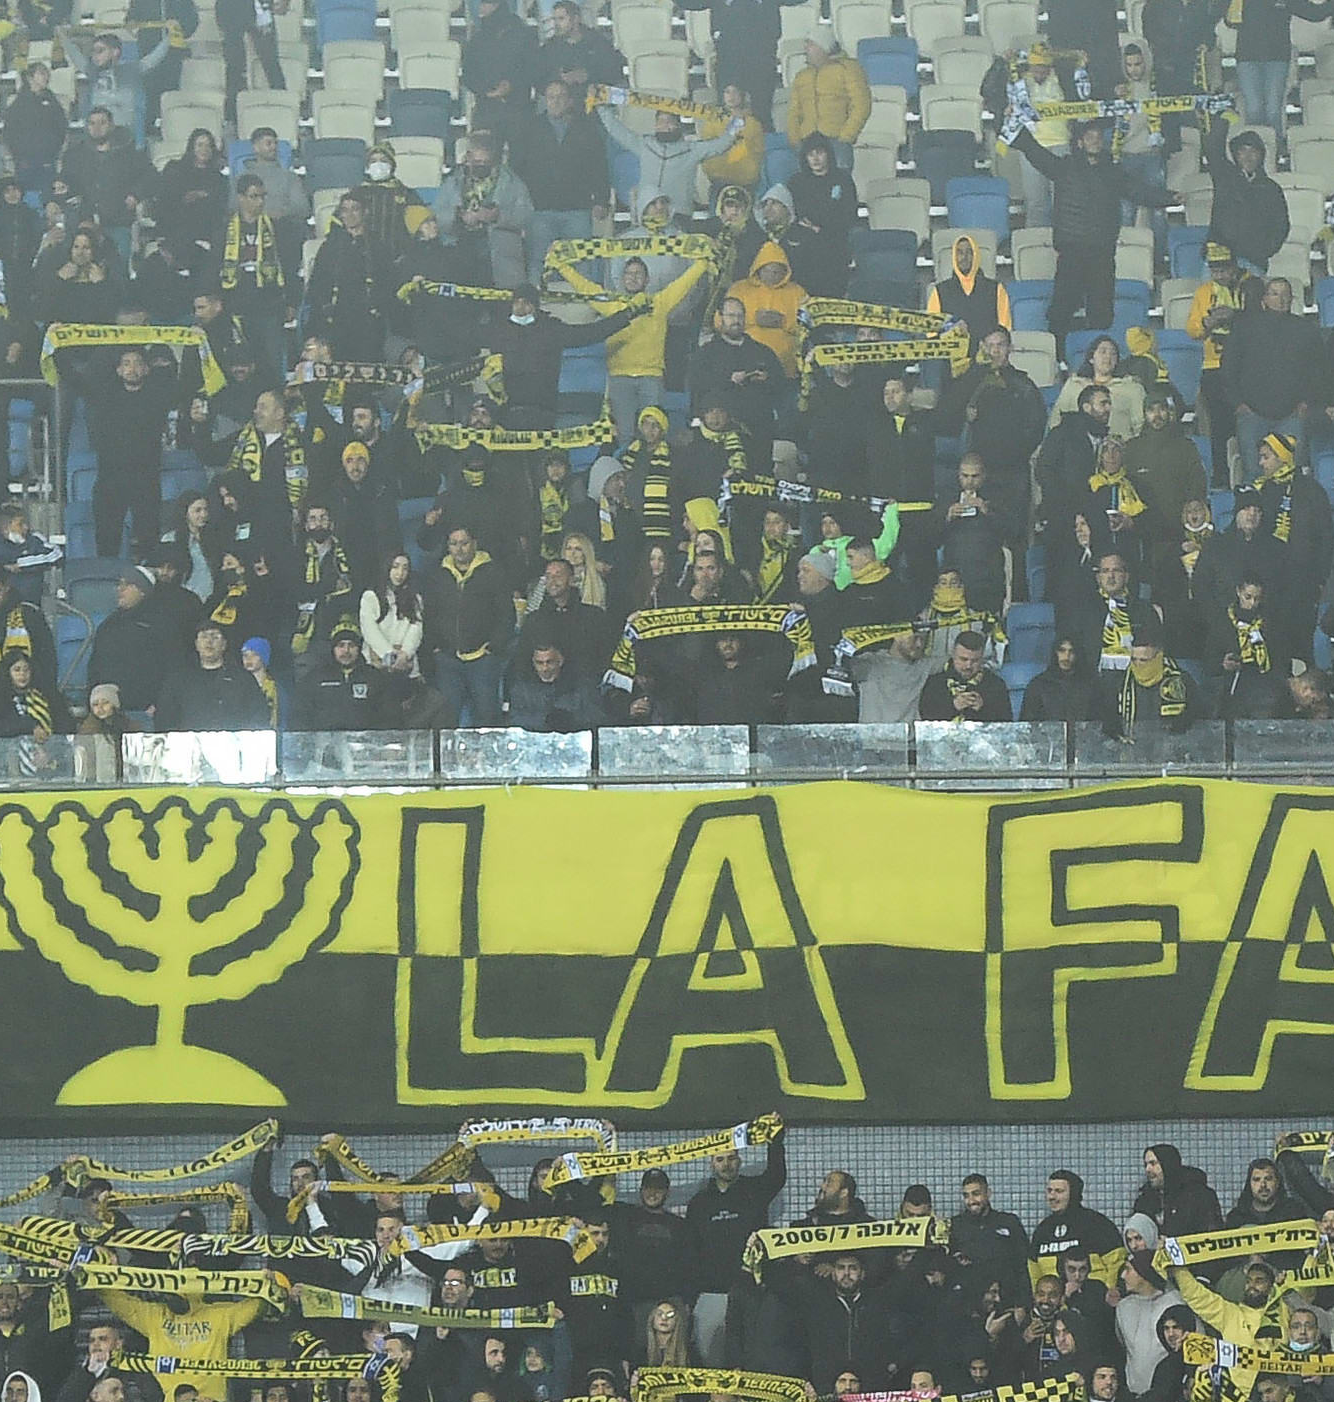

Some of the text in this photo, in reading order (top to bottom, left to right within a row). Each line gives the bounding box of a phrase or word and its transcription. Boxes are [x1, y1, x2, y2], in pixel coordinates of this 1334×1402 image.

[396, 800, 863, 1108] LA
[446, 1219, 540, 1236] ירושלים
[773, 1221, 921, 1247] אלופה 2006/7
[1186, 1226, 1316, 1255] בית"ר ירושלים
[94, 1271, 262, 1293] בית"ר ירושלים
